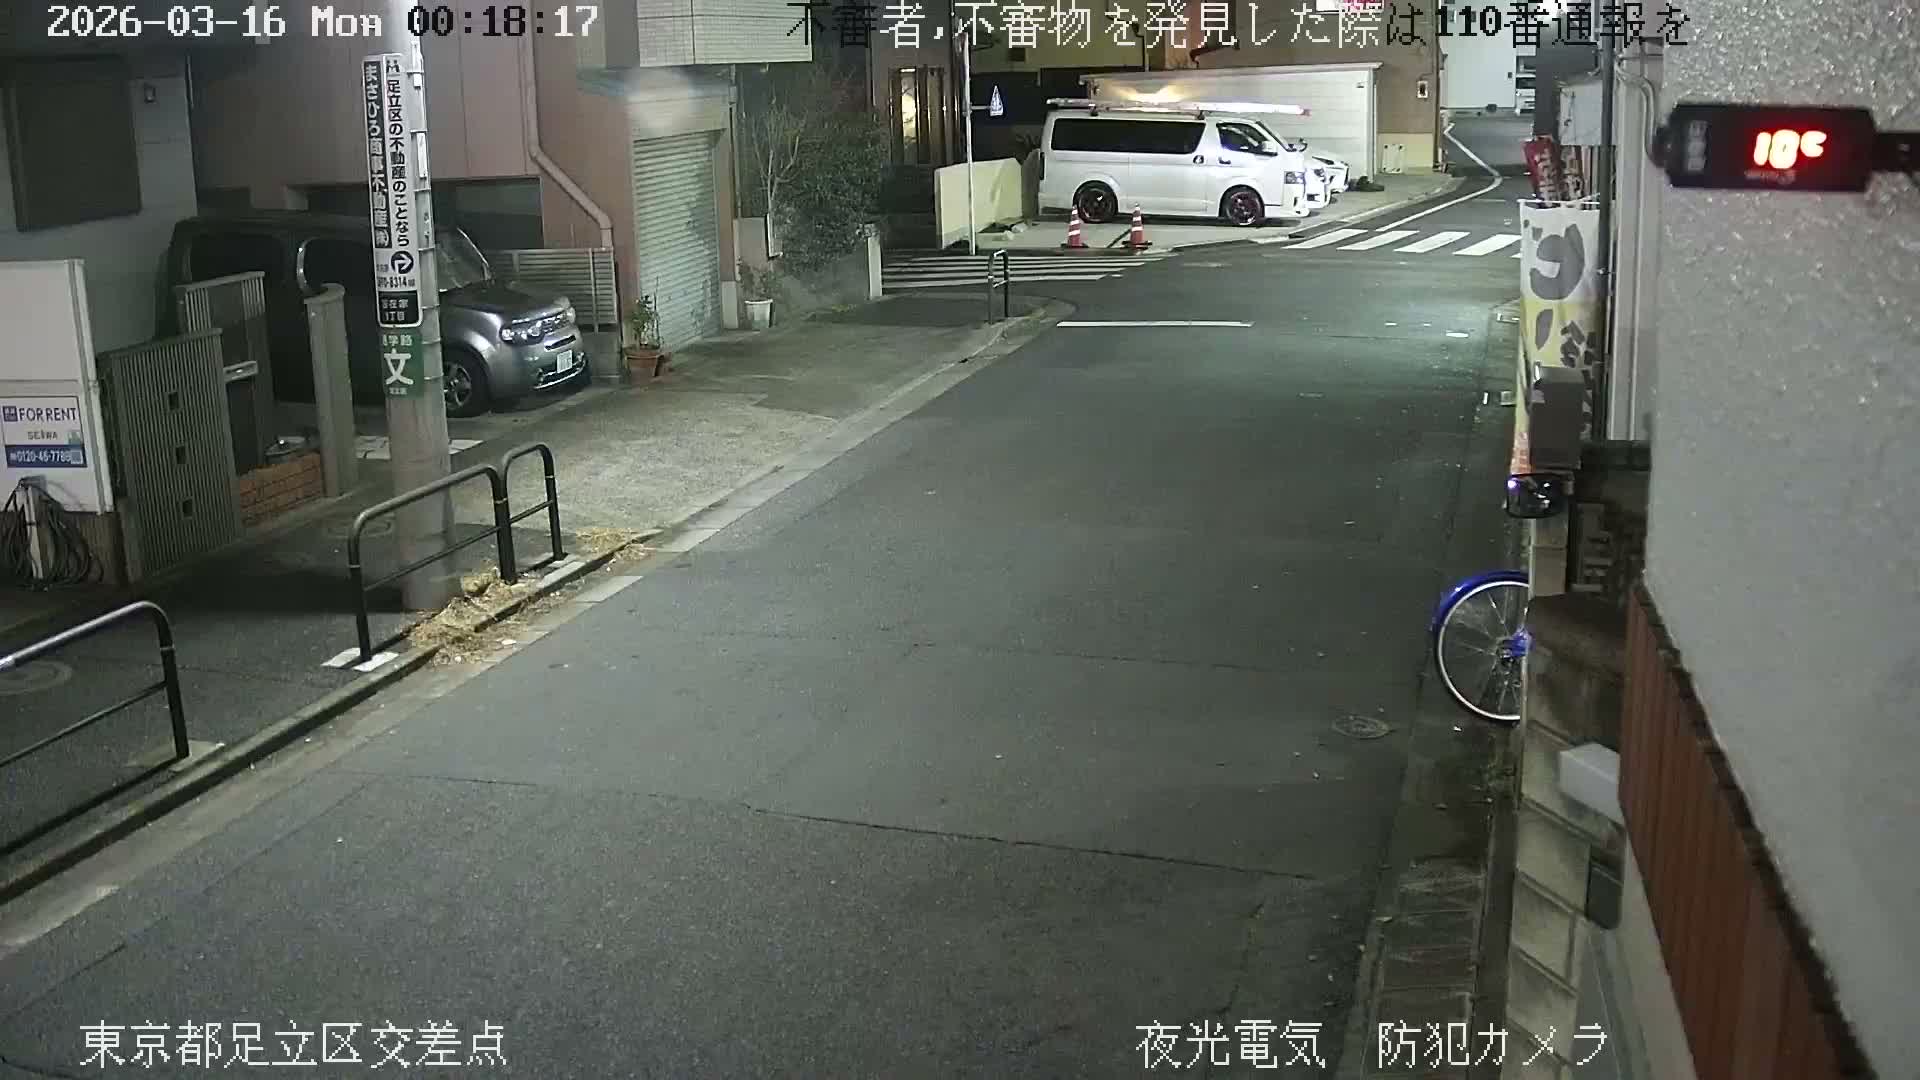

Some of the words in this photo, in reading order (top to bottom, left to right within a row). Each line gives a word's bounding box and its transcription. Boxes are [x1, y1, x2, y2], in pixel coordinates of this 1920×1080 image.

[386, 79, 410, 247] 足立区の不動産のことなら
[383, 348, 414, 386] 文
[18, 407, 45, 422] FOR
[46, 407, 77, 422] RENT
